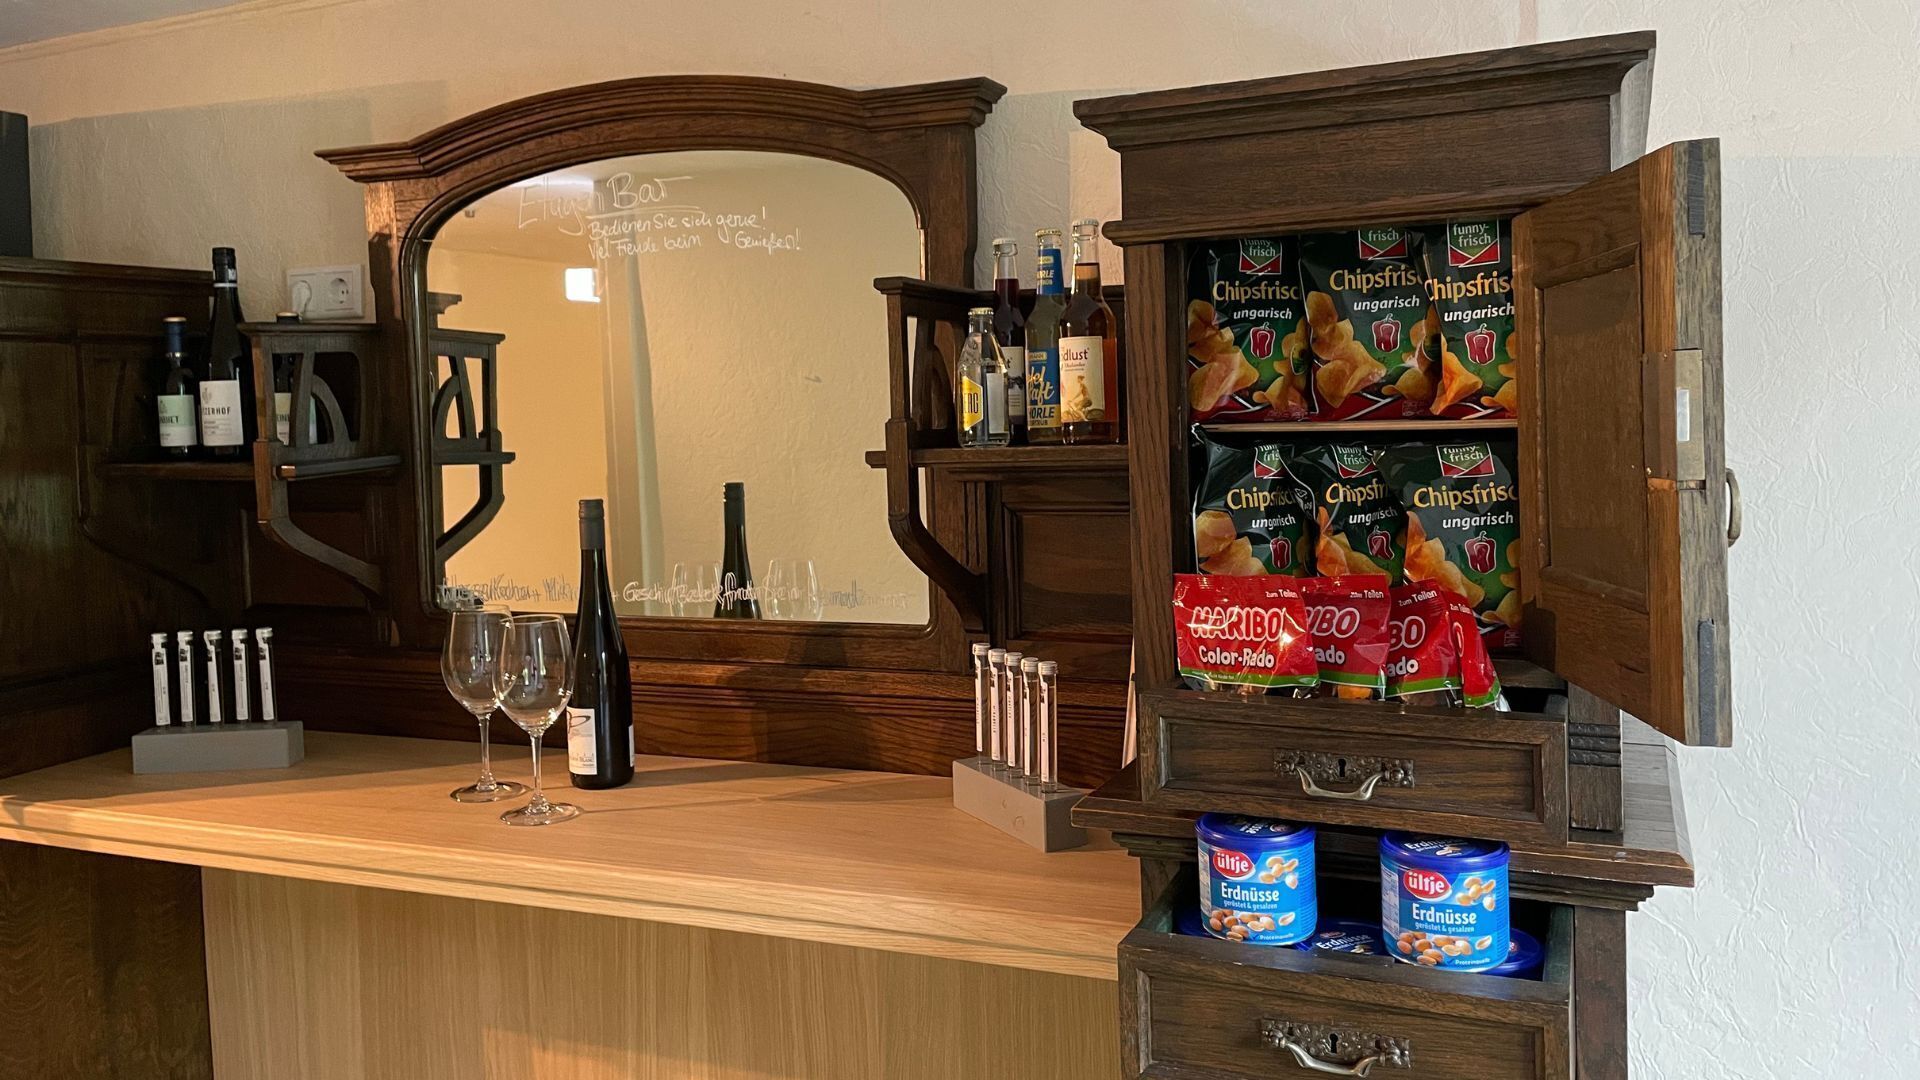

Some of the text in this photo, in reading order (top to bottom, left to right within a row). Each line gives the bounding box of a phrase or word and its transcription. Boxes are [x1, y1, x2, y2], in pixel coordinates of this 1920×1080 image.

[606, 172, 693, 209] Bar
[588, 206, 767, 244] Bedienen Sie sich gerne!
[1453, 223, 1489, 238] funny-
[1368, 229, 1399, 241] frisch
[1458, 233, 1492, 247] frisch
[1250, 245, 1276, 256] frisch
[1212, 280, 1299, 303] Chipsfrisc
[1353, 295, 1420, 312] ungarisch
[1444, 303, 1515, 322] ungarisch
[1233, 307, 1292, 320] ungarisch
[1450, 451, 1483, 462] frisch
[1414, 481, 1518, 510] Chipsfrisc
[1252, 514, 1296, 530] ungarisch
[1442, 511, 1515, 530] ungarisch
[1363, 589, 1384, 599] Teilen
[1398, 590, 1438, 607] Zum Teilen
[1190, 606, 1283, 642] HARIBO
[1217, 851, 1250, 873] ültje
[1221, 882, 1280, 902] Erdnüsse
[1408, 871, 1445, 895] ültje
[1412, 903, 1478, 925] Erdnüsse
[1448, 924, 1475, 935] gesalzen
